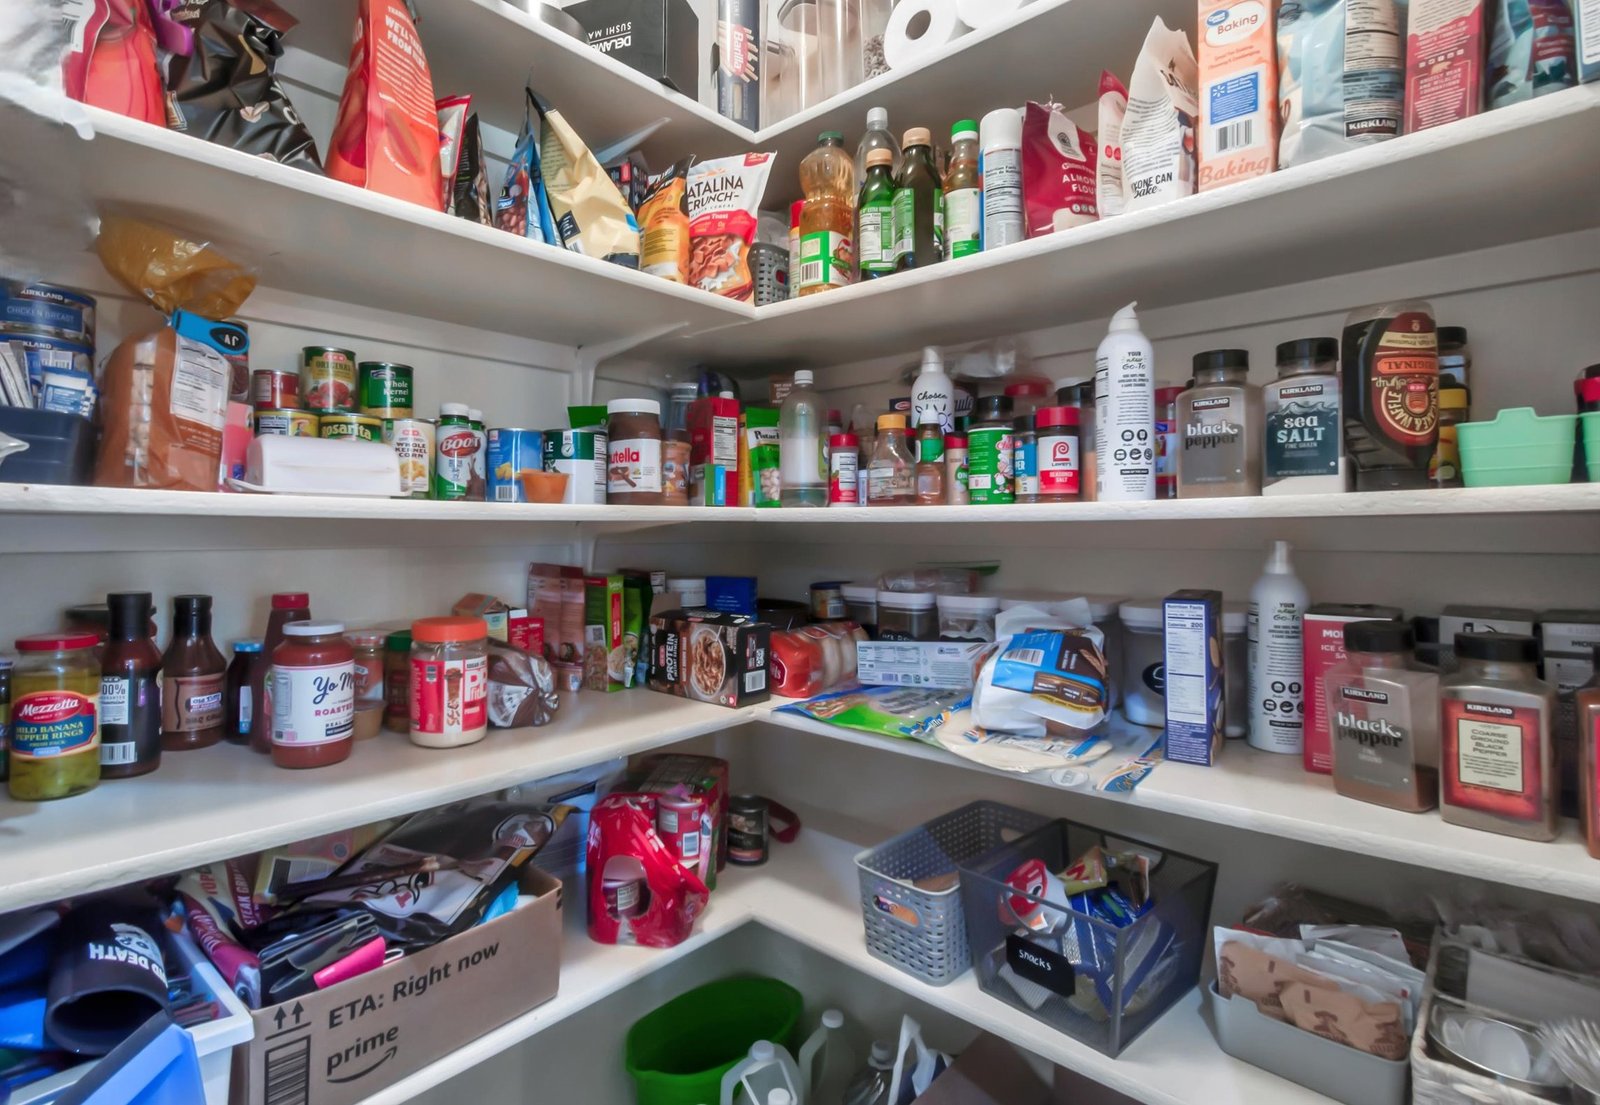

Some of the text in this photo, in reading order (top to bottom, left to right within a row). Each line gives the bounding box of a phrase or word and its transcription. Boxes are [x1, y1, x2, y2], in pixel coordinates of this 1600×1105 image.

[606, 21, 632, 36] SUSHI
[1217, 14, 1259, 35] Baking
[733, 30, 744, 71] Barilla
[1349, 118, 1397, 130] KIRKLAND
[1199, 156, 1271, 185] Baking
[1155, 172, 1172, 185] CAN
[6, 305, 75, 323] CHICKEN BREAST
[384, 380, 408, 388] Whole
[1281, 385, 1322, 395] KIRKLAND
[383, 388, 409, 396] Kernel
[917, 390, 948, 401] Chosen
[1193, 398, 1229, 408] KIRKLAND
[1387, 390, 1414, 429] WAFFLE
[1186, 420, 1239, 437] black
[1284, 415, 1319, 429] sea
[1185, 434, 1238, 451] pepper
[1276, 427, 1326, 443] SALT
[442, 436, 482, 451] BOOT
[1320, 643, 1336, 652] ICE
[666, 633, 676, 681] PROTEIN
[313, 676, 339, 705] Yo
[1343, 688, 1387, 700] KIRKLAND
[19, 697, 79, 717] Mezzetta
[1466, 703, 1513, 715] KIRKLAND
[16, 721, 84, 734] MILD BANANA
[1338, 711, 1402, 738] black
[16, 729, 84, 742] PEPPER RINGS
[1338, 726, 1403, 748] pepper
[1470, 734, 1510, 746] GROUND
[1471, 728, 1509, 739] COARSE
[1472, 747, 1508, 758] PEPPER
[1474, 741, 1505, 751] BLACK
[236, 895, 258, 926] STEAK
[89, 942, 150, 970] DEATH
[1018, 948, 1053, 972] Snacks
[328, 942, 500, 1030] ETA: Right now
[326, 1025, 400, 1076] prime
